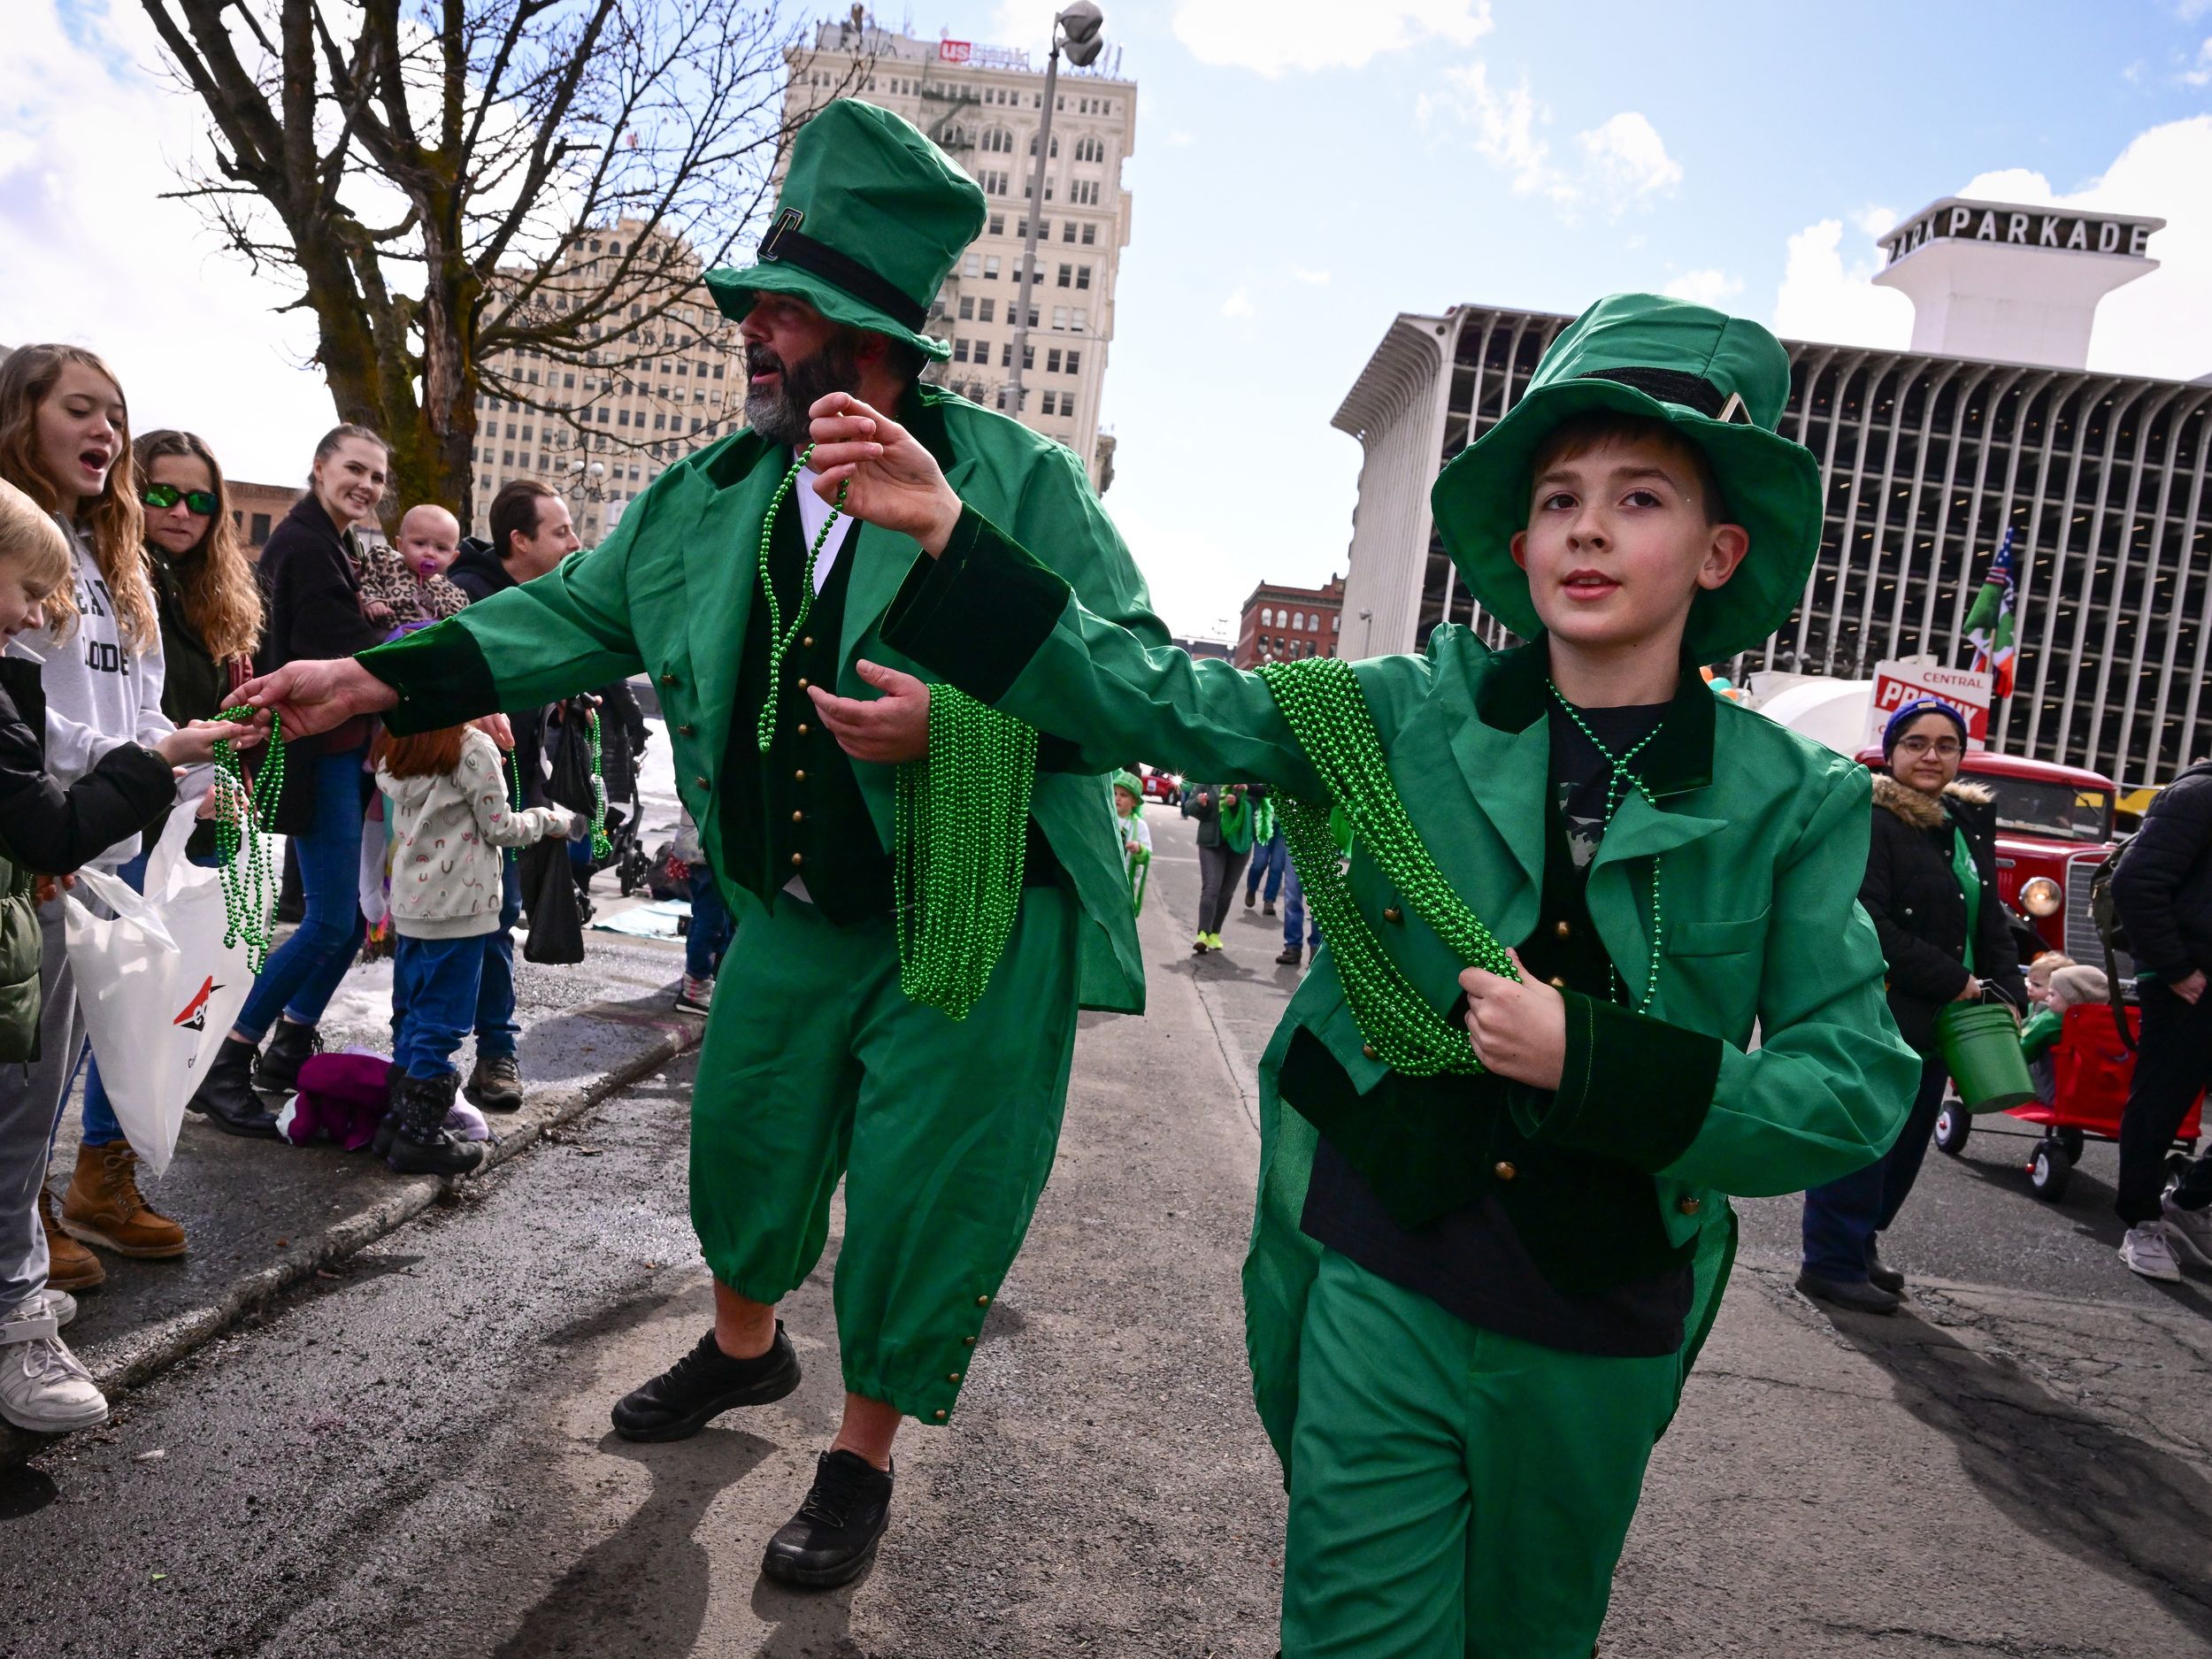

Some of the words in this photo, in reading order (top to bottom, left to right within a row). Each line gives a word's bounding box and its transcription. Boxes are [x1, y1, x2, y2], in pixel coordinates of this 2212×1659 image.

[1886, 212, 1937, 262] PARK
[1948, 207, 2150, 257] PARKADE
[1923, 672, 1984, 689] CENTRAL
